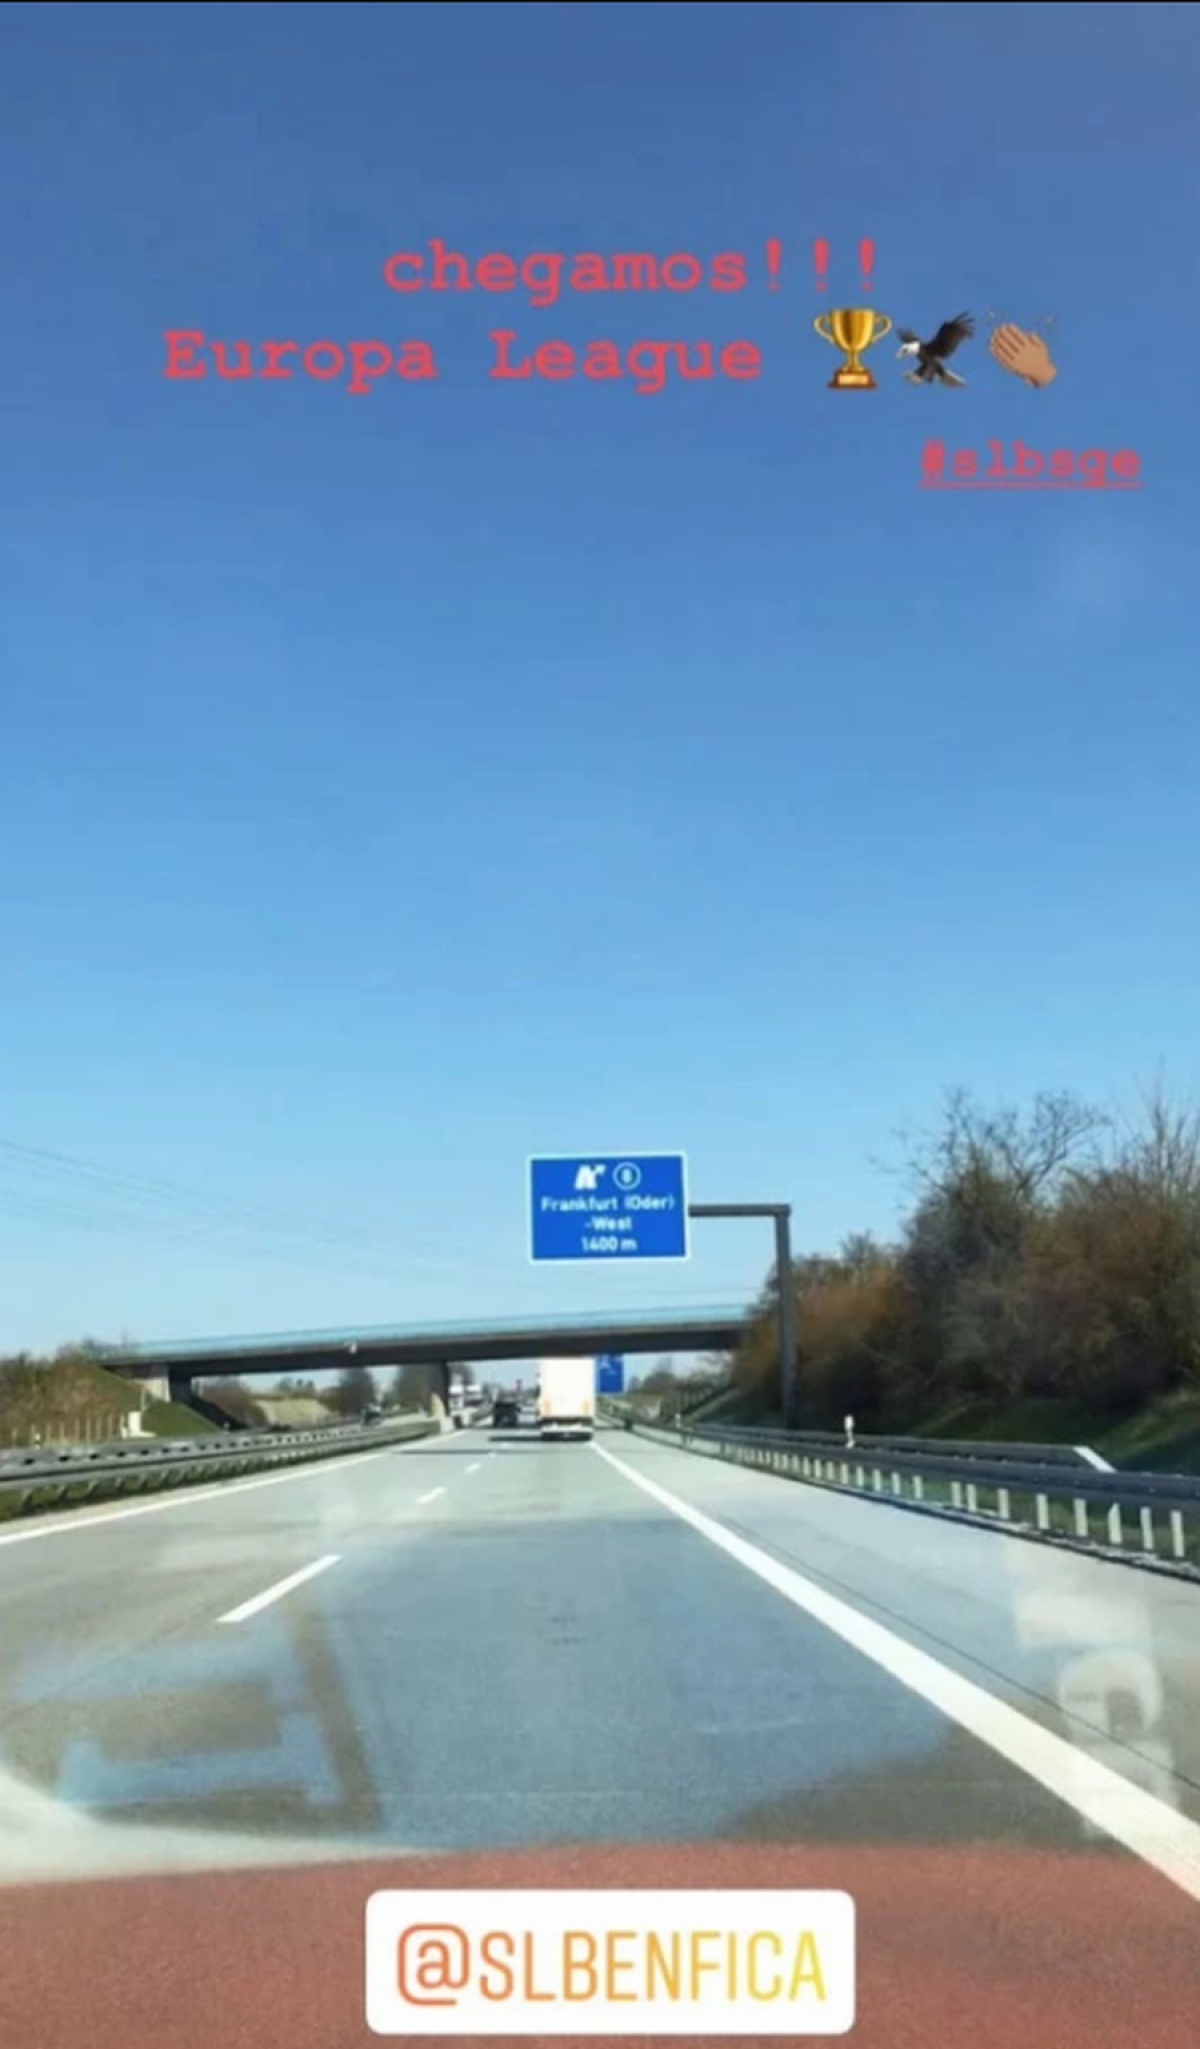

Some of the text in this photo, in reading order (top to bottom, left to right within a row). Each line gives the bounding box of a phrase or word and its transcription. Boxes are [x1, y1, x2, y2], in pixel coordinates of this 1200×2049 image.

[541, 1194, 675, 1211] Frankfurt (Oder)
[584, 1216, 632, 1231] -West
[581, 1236, 637, 1250] 1400 m
